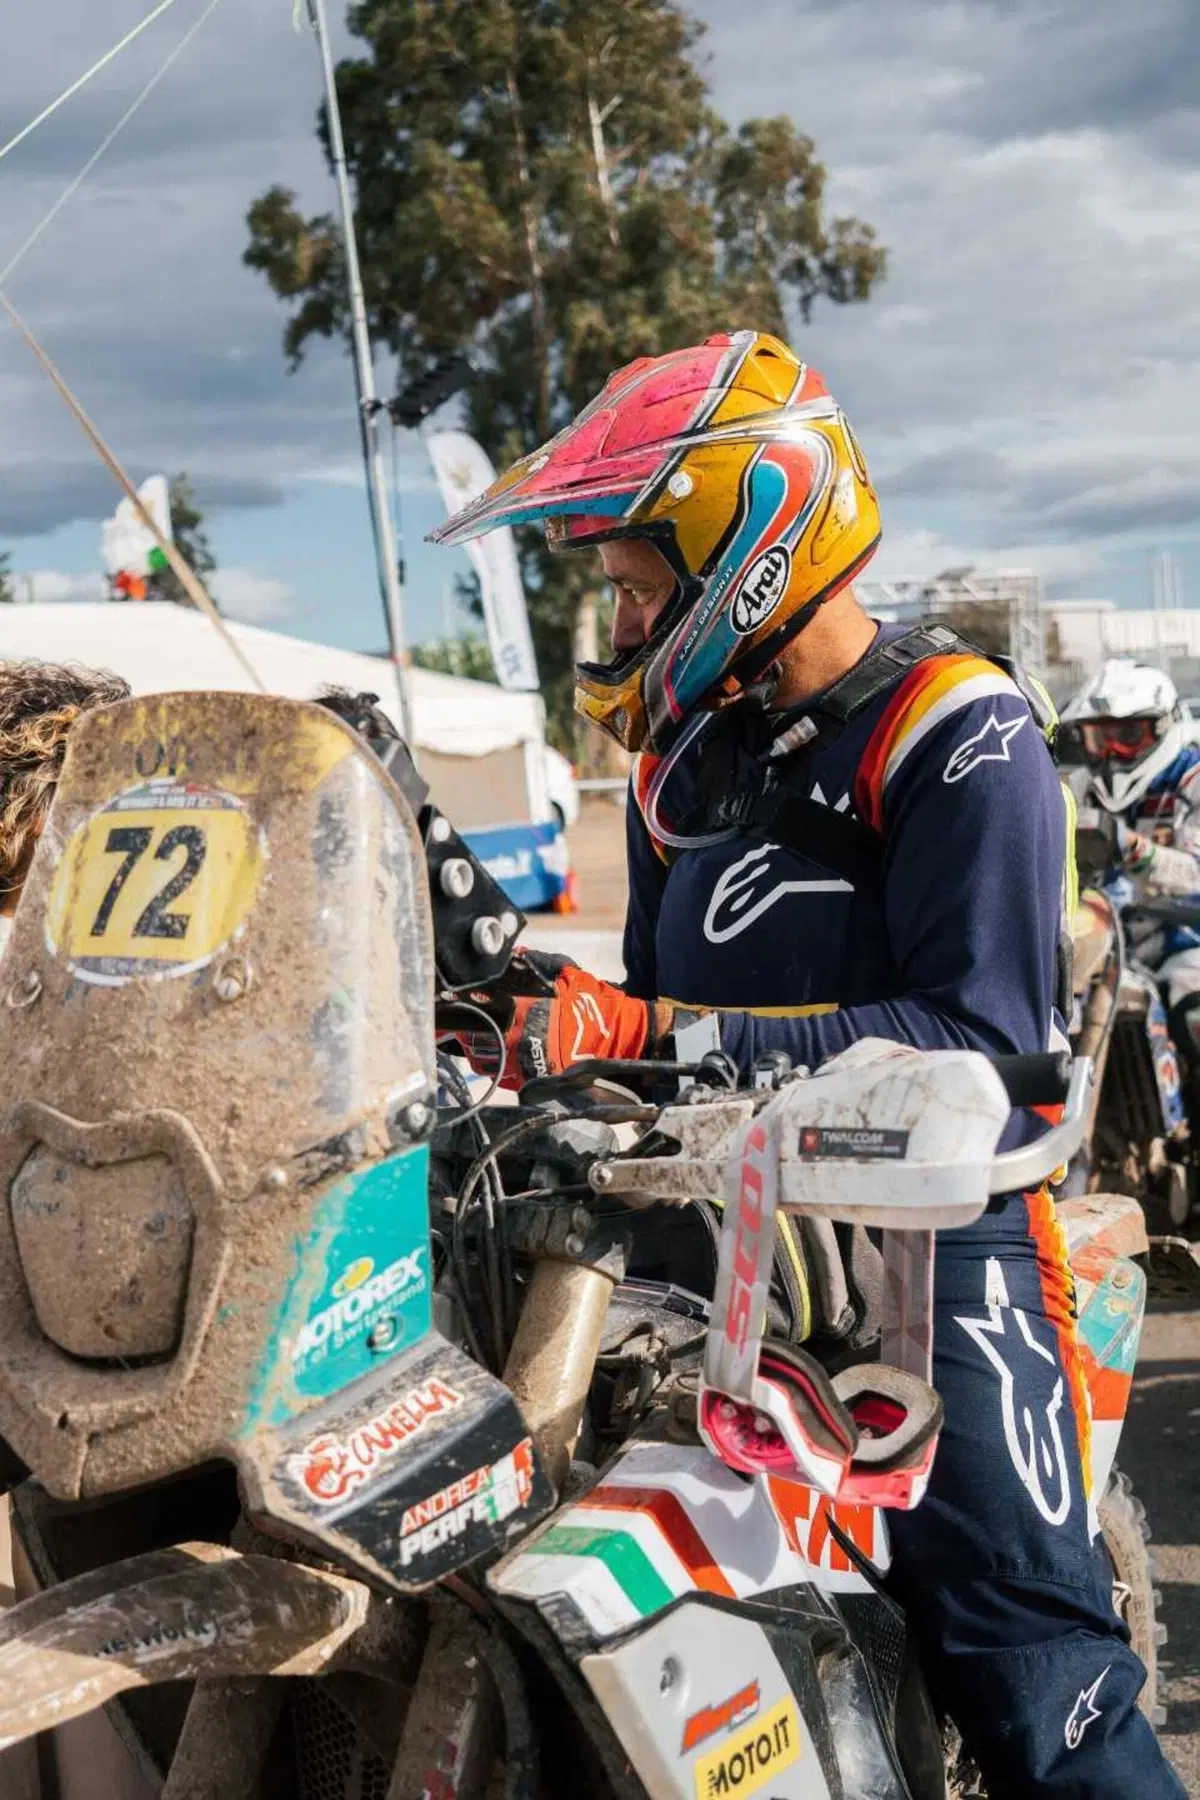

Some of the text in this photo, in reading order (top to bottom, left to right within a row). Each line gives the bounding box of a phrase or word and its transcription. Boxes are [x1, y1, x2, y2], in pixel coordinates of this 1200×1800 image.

[740, 553, 782, 630] Arai
[91, 825, 206, 939] 72
[291, 1246, 427, 1362] MOTOREX
[401, 1464, 495, 1536] ANDREA
[707, 1714, 790, 1799] MOTO.IT
